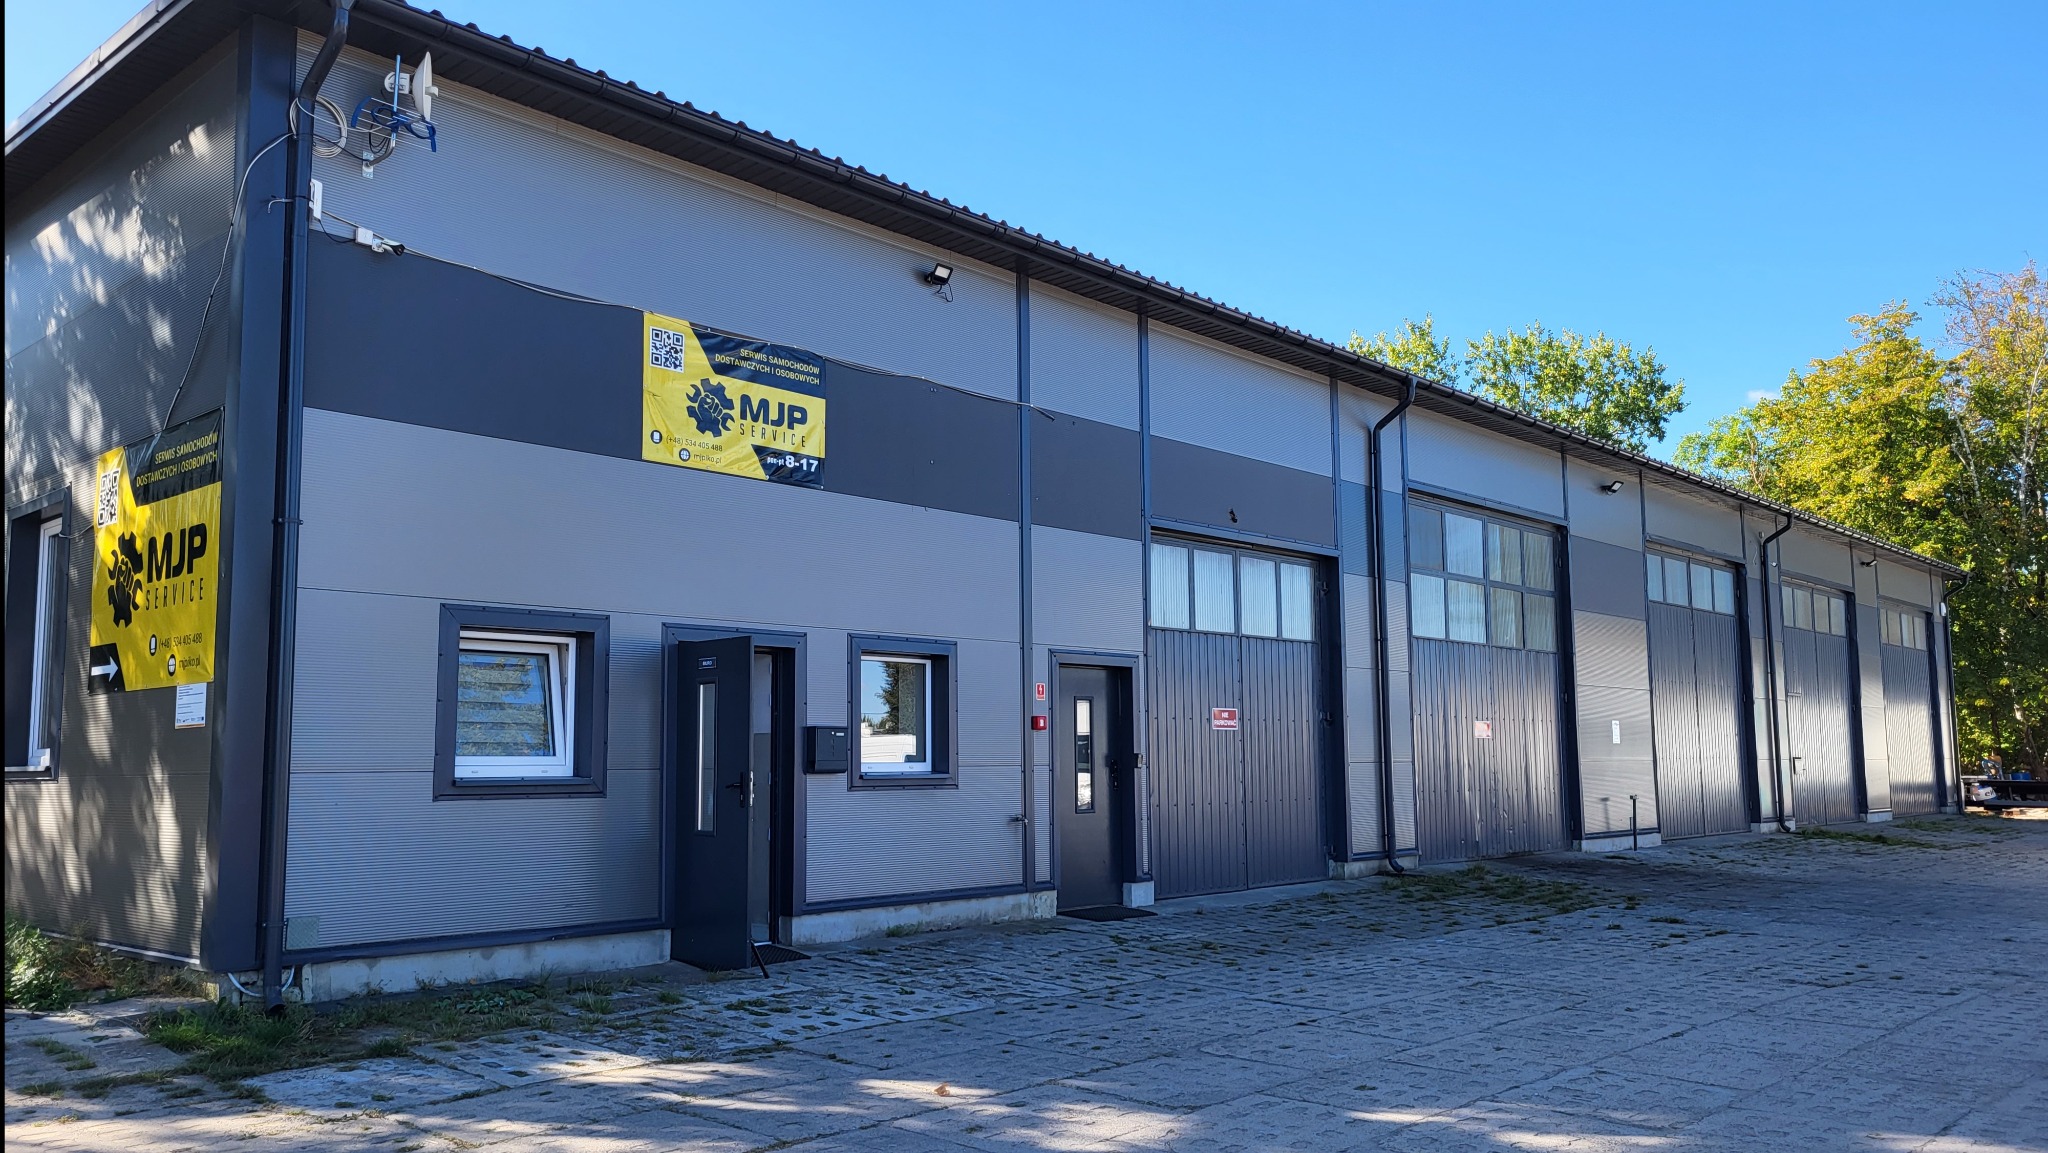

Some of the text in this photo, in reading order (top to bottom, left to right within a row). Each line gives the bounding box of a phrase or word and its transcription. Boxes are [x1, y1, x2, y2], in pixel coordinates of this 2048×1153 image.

[715, 354, 770, 374] DOSTAWCZYCH
[775, 368, 820, 385] OSOBOWYCH
[740, 349, 820, 374] SERWIS SAMOCHODÓW
[740, 394, 808, 430] MJP
[155, 431, 219, 464] SERWIS SAMOCHODÓW
[666, 435, 723, 452] (+48) 534 405 488
[740, 423, 806, 448] SERVICE
[136, 450, 218, 488] DOSTAWCZYCH I OSOBOWYCH
[785, 455, 819, 472] 8-17
[147, 523, 208, 584] MJP
[146, 577, 204, 611] SERVICE
